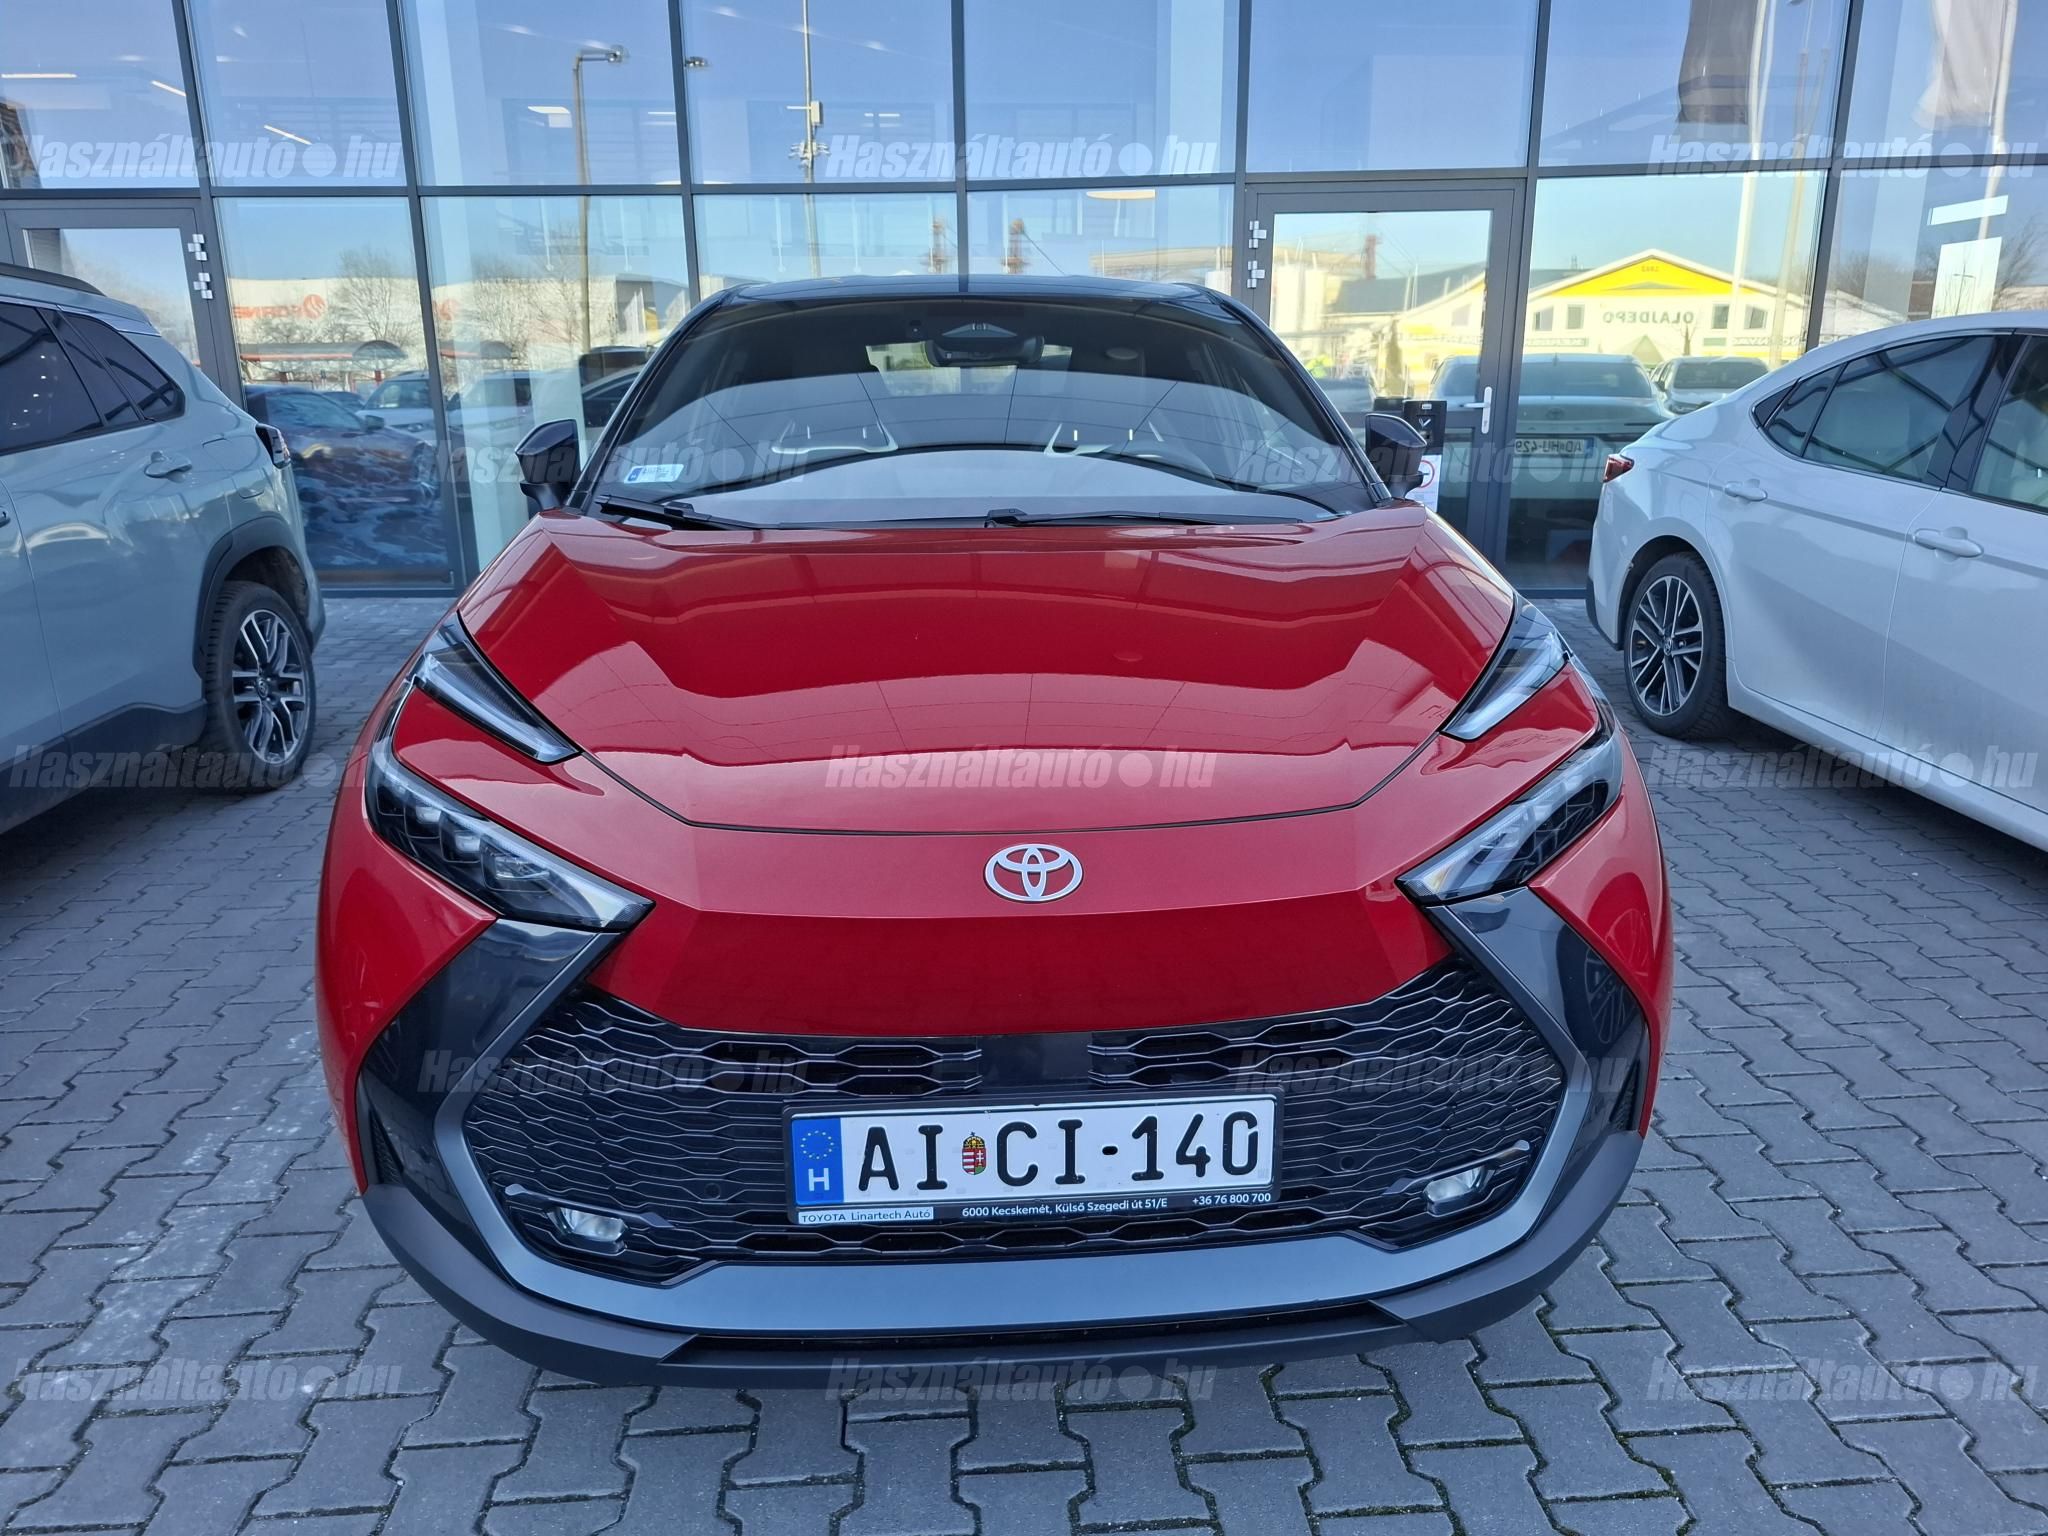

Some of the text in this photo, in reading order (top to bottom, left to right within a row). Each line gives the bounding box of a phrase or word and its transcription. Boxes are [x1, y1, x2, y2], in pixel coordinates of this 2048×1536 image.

[807, 1167, 830, 1192] H
[961, 1197, 1168, 1217] 6000 Kecskemét, Külső Szegedi út 51/E
[1192, 1192, 1271, 1206] +36 76 800 700
[801, 1208, 931, 1223] TOYOTA Linartech Autó
